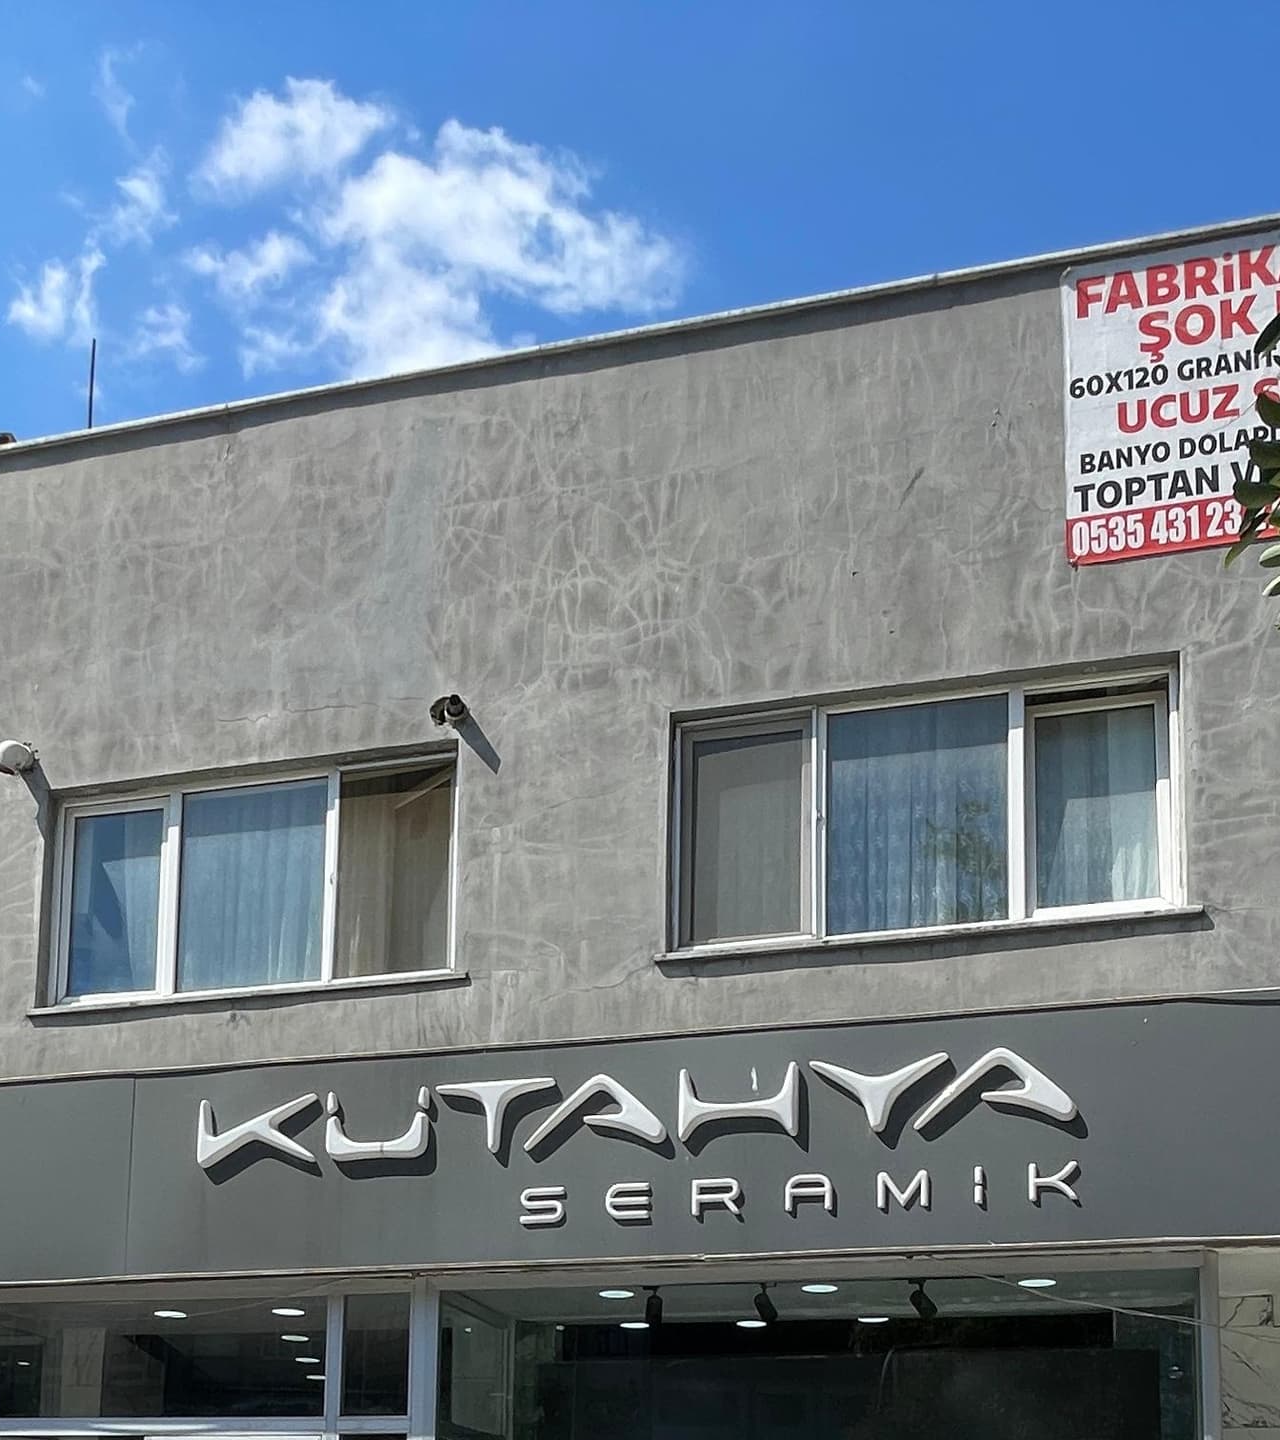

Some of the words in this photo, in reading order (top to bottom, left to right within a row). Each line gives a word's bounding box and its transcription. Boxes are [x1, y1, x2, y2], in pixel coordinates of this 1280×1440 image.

[1138, 294, 1259, 363] ŞOK
[1070, 364, 1169, 399] 60X120
[1117, 384, 1240, 434] UCUZ
[1079, 441, 1170, 475] BANYO
[1074, 464, 1220, 512] TOPTAN
[1072, 514, 1145, 557] 0535
[1150, 507, 1201, 551] 431
[1206, 501, 1243, 540] 23
